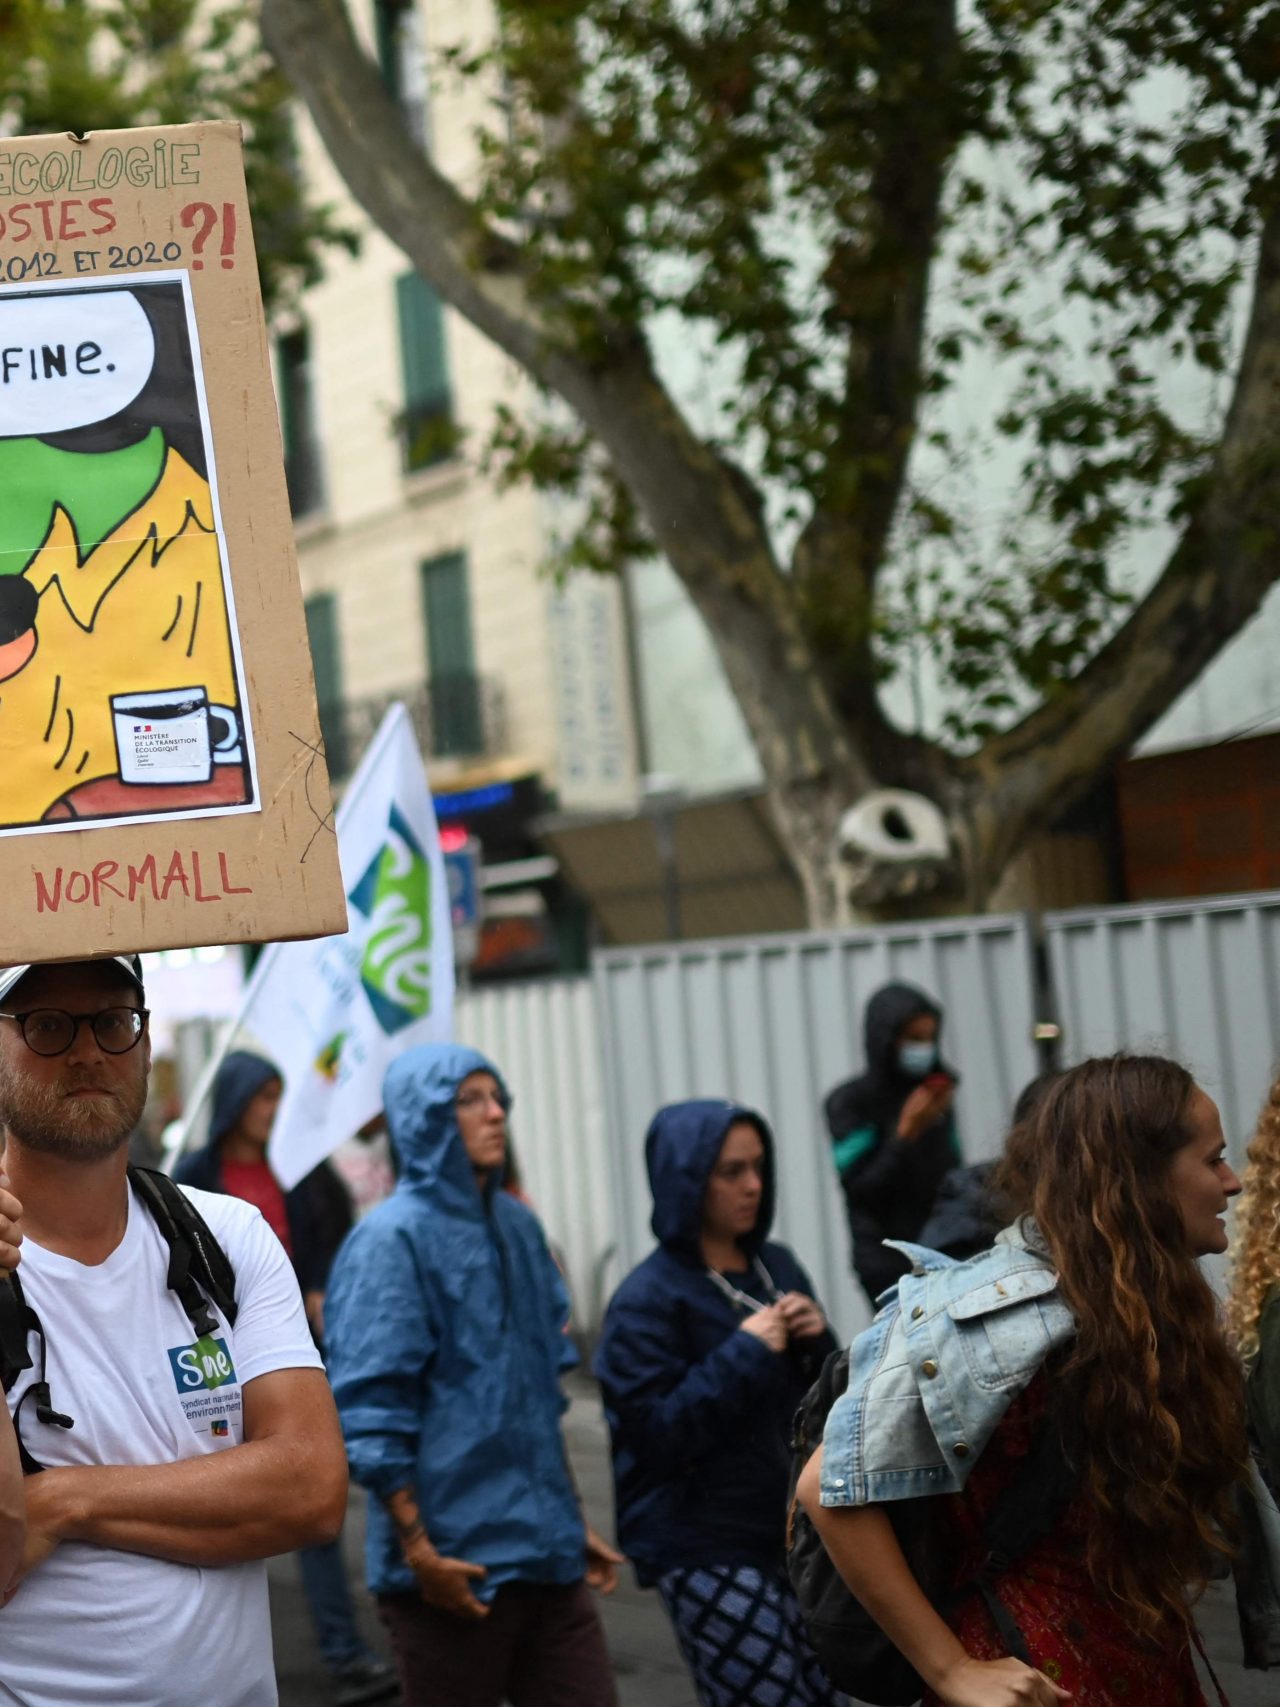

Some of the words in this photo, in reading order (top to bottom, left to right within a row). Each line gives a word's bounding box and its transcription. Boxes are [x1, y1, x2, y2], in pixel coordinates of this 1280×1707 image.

[180, 202, 236, 270] ?!
[74, 250, 100, 272] ET
[108, 242, 181, 268] 2020
[155, 738, 197, 746] TRANSITION
[35, 850, 253, 913] NORMALL
[177, 1349, 231, 1386] Sne
